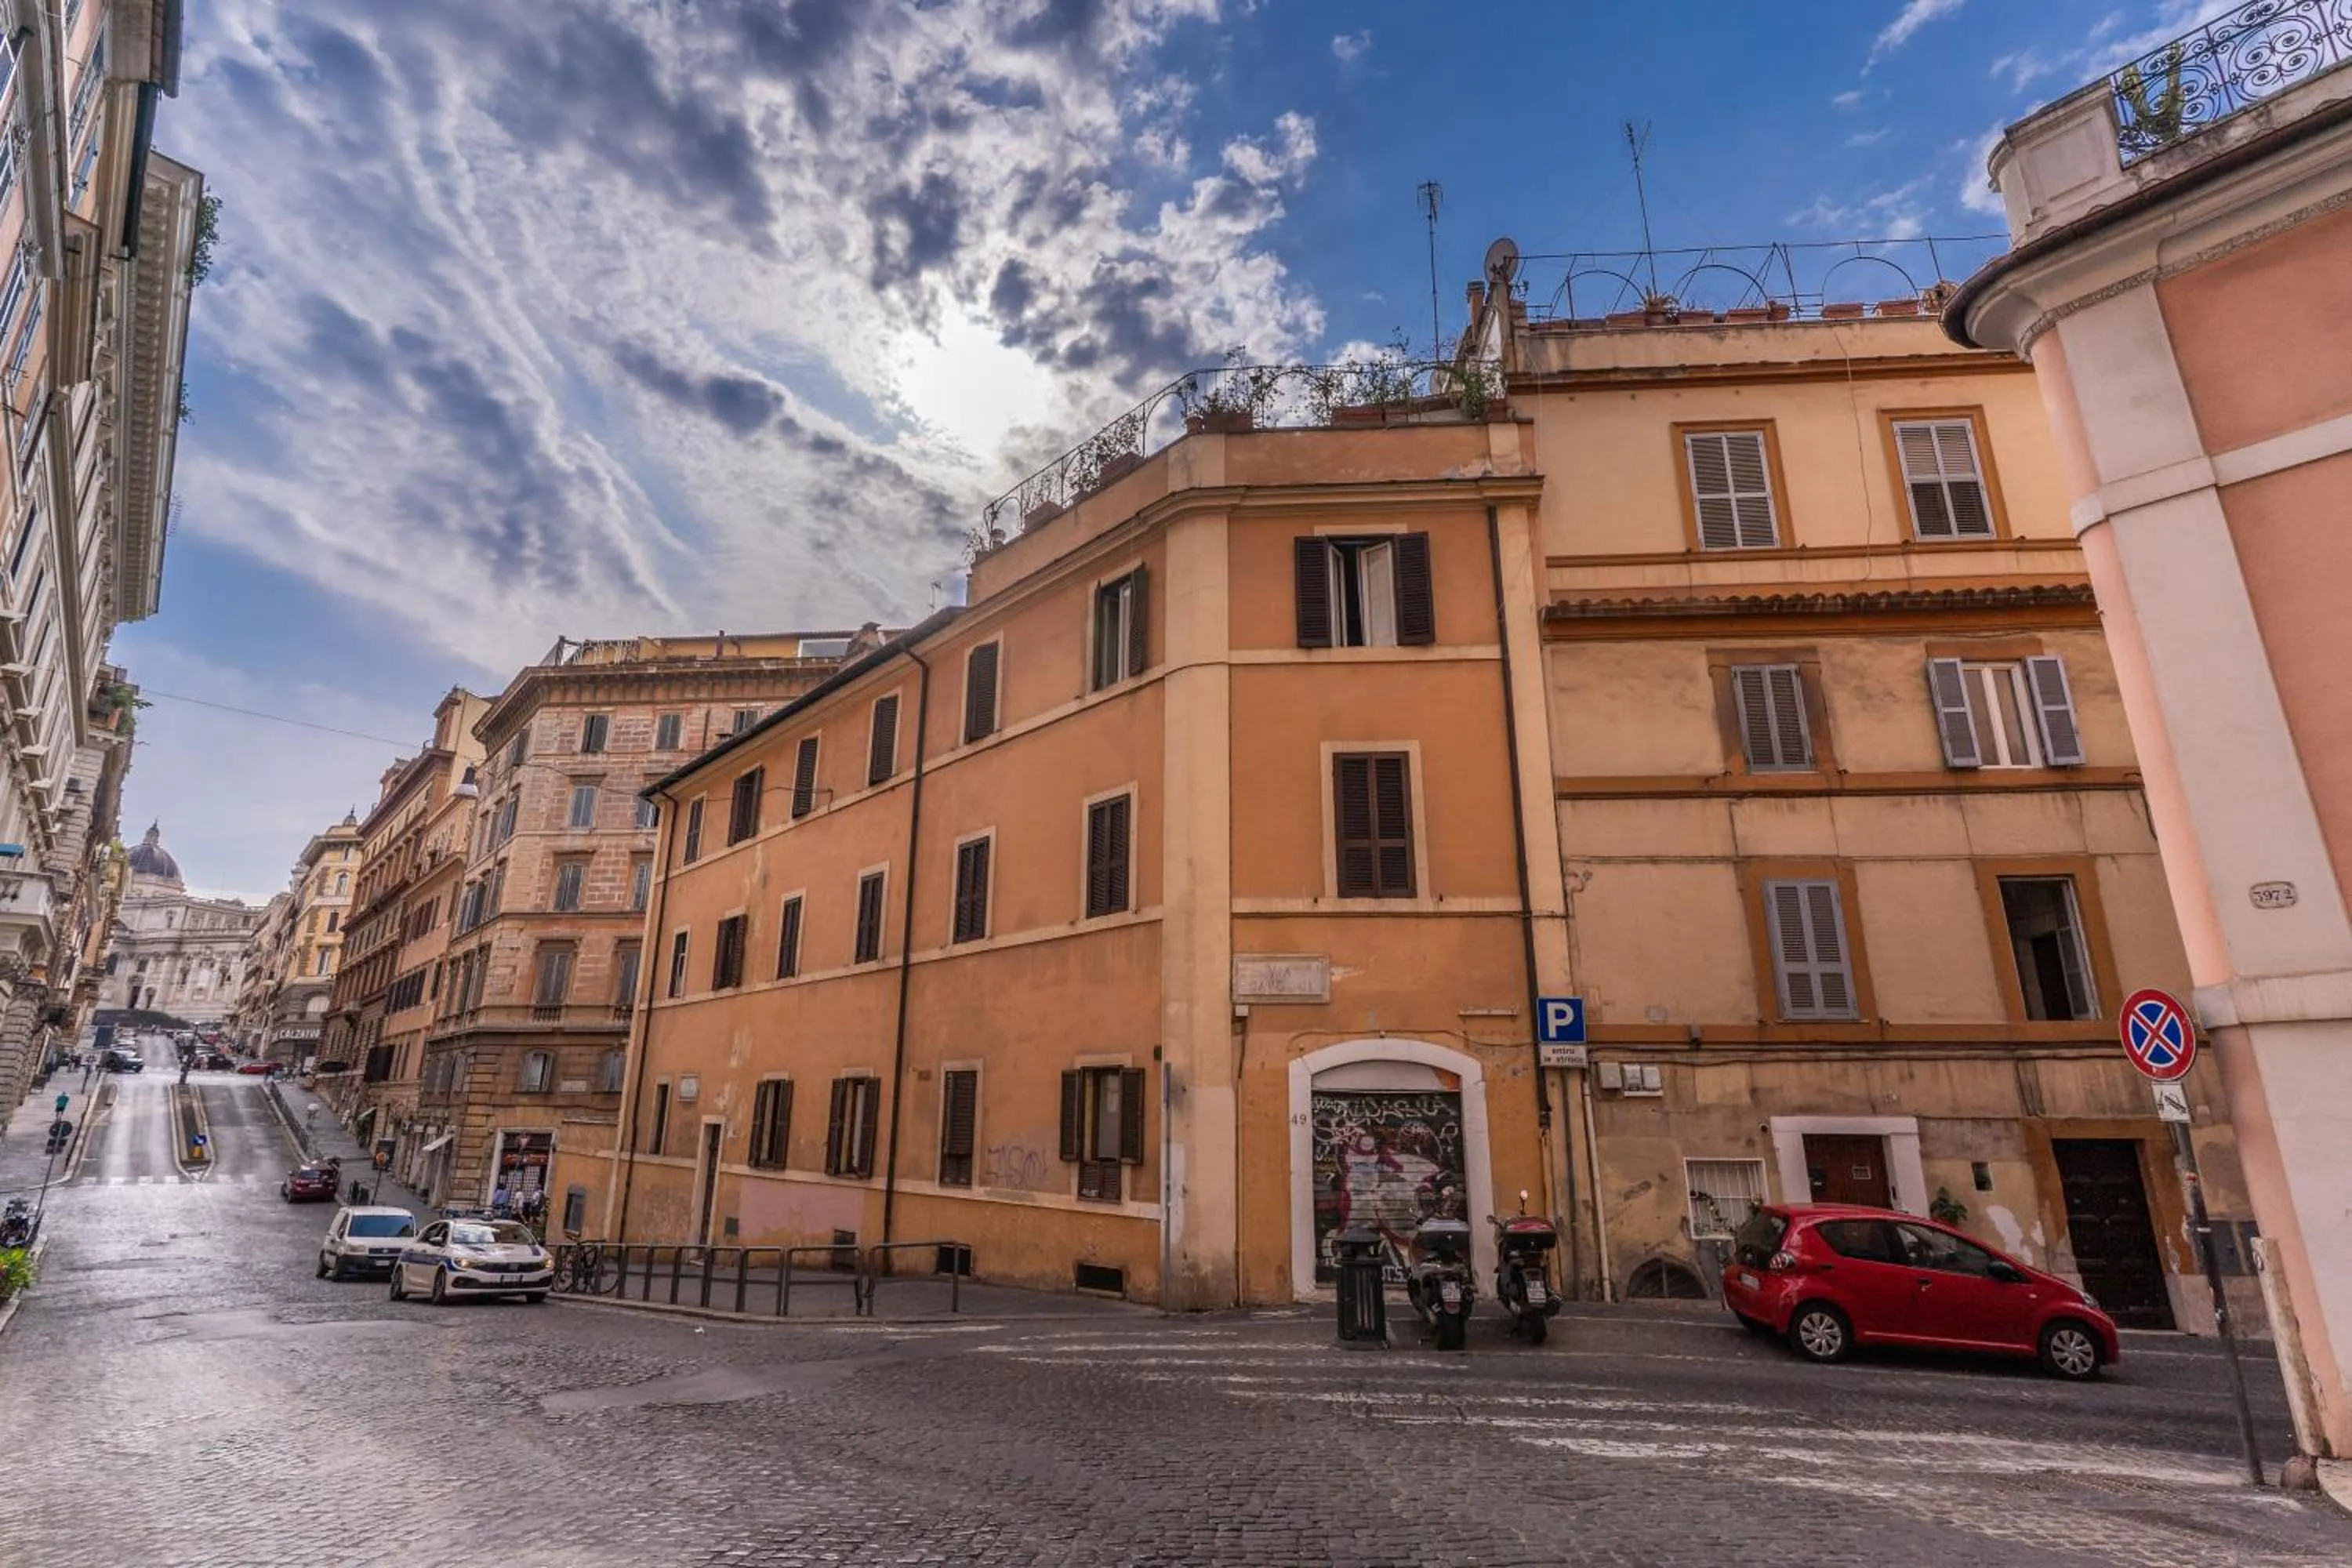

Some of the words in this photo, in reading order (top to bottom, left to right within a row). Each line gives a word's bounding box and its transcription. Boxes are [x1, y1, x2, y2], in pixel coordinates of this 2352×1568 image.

[1267, 964, 1291, 978] VIA
[1546, 1002, 1574, 1039] P
[1291, 1113, 1307, 1125] 49
